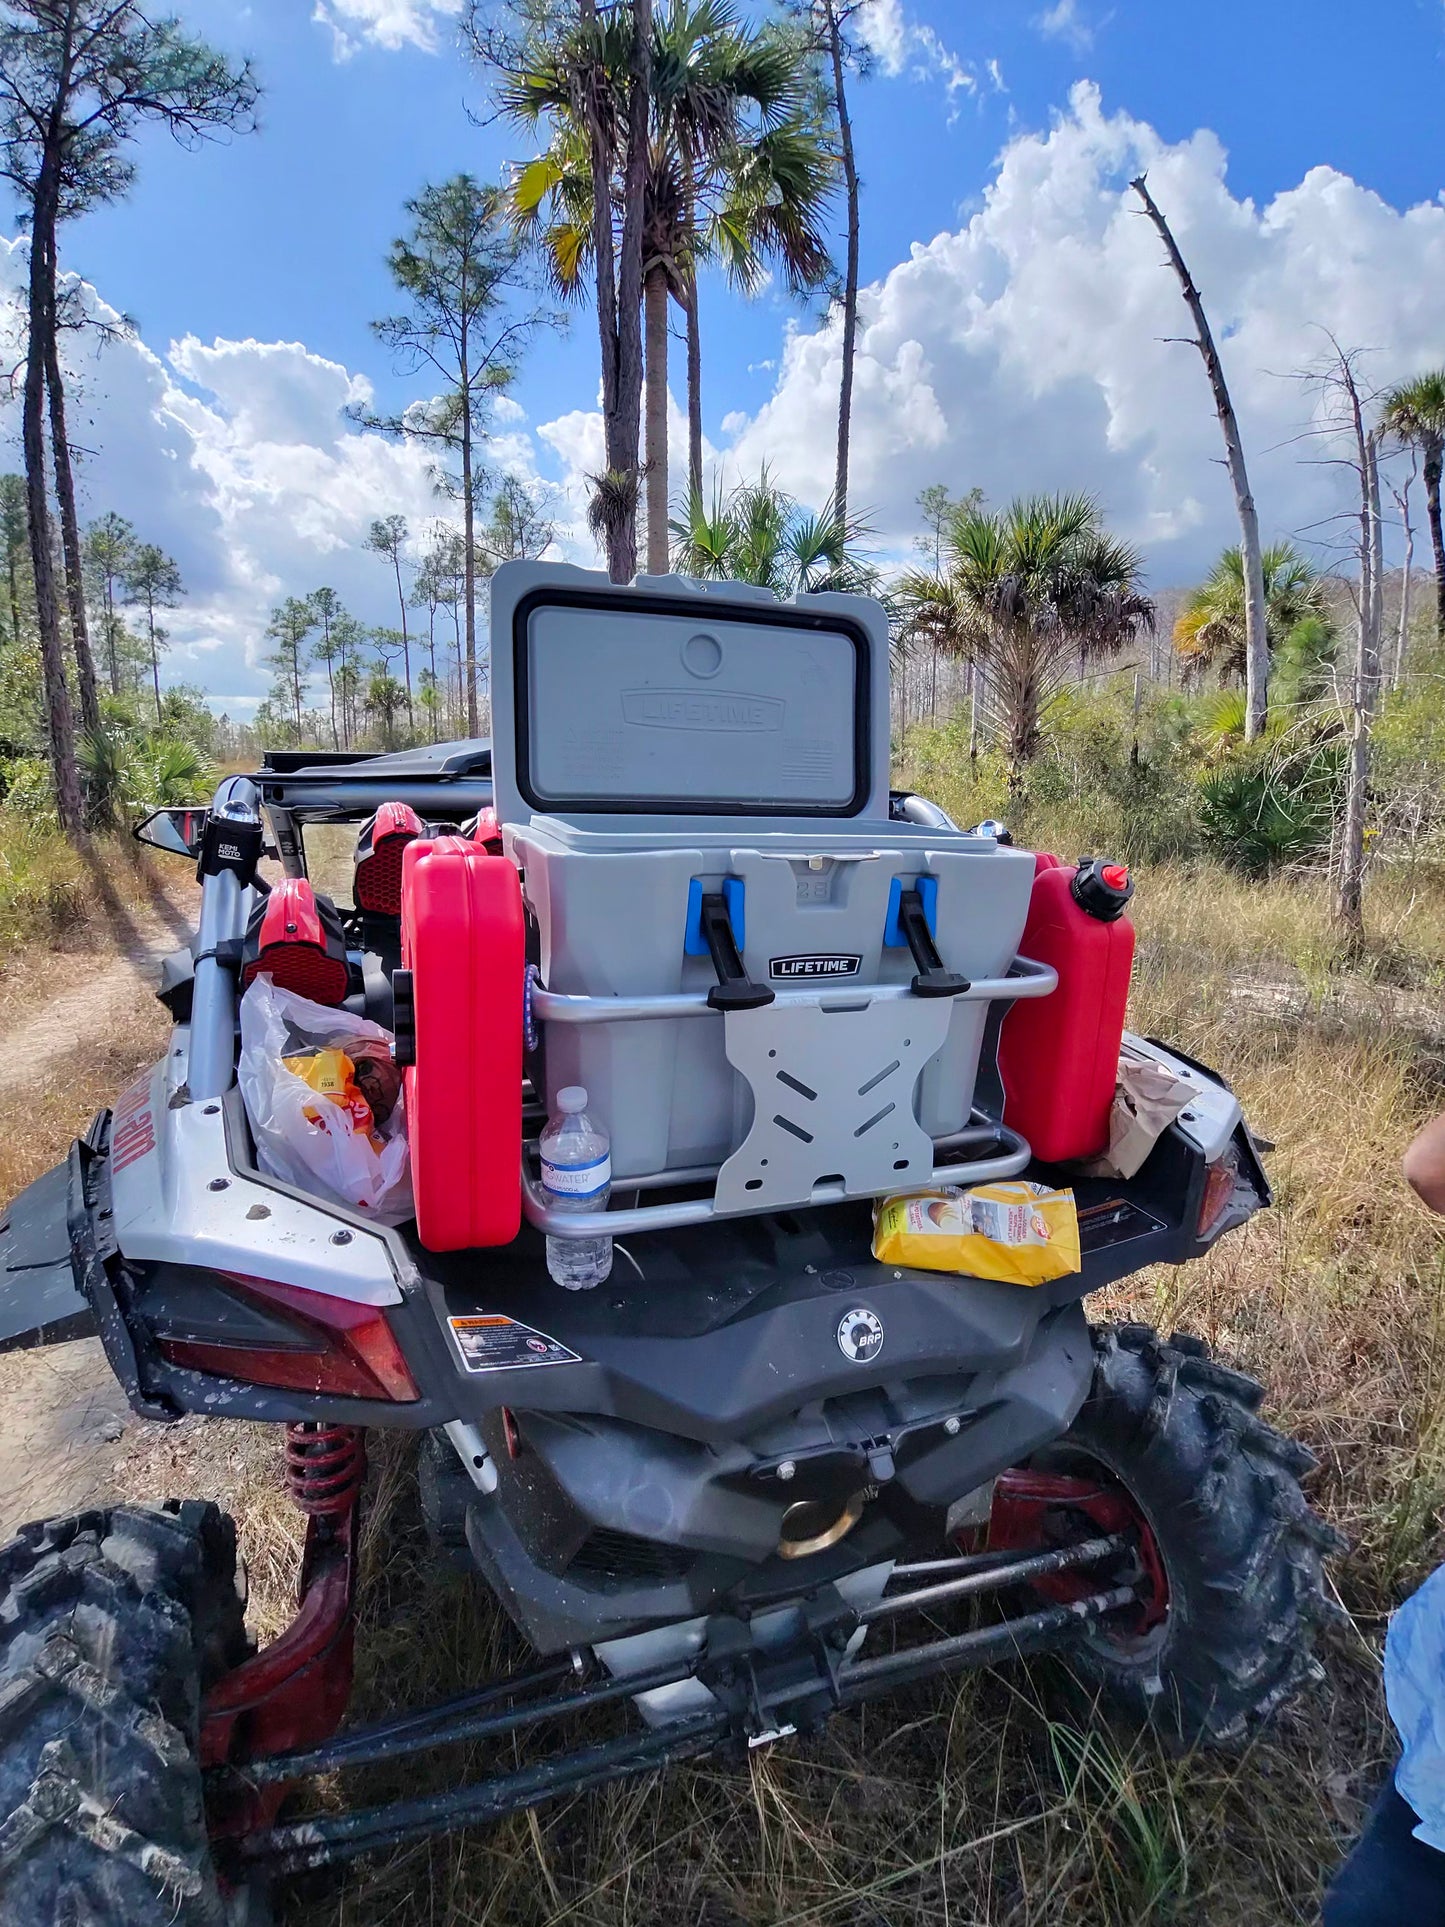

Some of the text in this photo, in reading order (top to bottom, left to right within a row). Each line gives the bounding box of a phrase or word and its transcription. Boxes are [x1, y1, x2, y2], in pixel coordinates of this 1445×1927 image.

[643, 701, 766, 725] LIFETIME
[218, 849, 240, 857] MOTO
[219, 843, 238, 851] KEMI
[781, 959, 849, 974] LIFETIME
[859, 1332, 882, 1347] BRP
